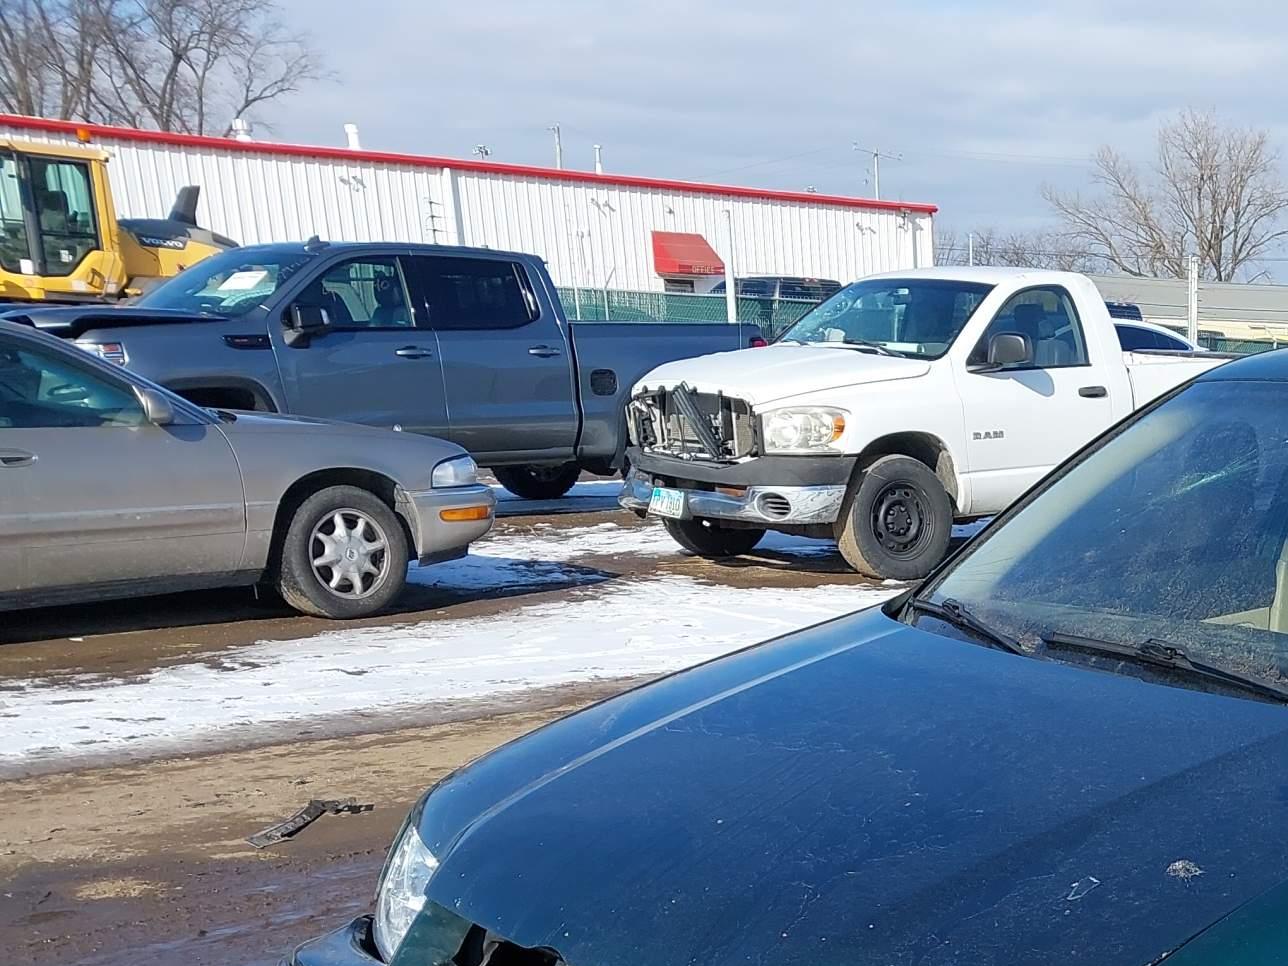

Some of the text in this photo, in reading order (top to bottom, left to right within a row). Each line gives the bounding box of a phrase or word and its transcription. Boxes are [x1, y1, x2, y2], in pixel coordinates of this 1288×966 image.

[142, 237, 183, 248] VOLVO
[691, 265, 715, 273] OFFICE
[973, 430, 1004, 440] RAM
